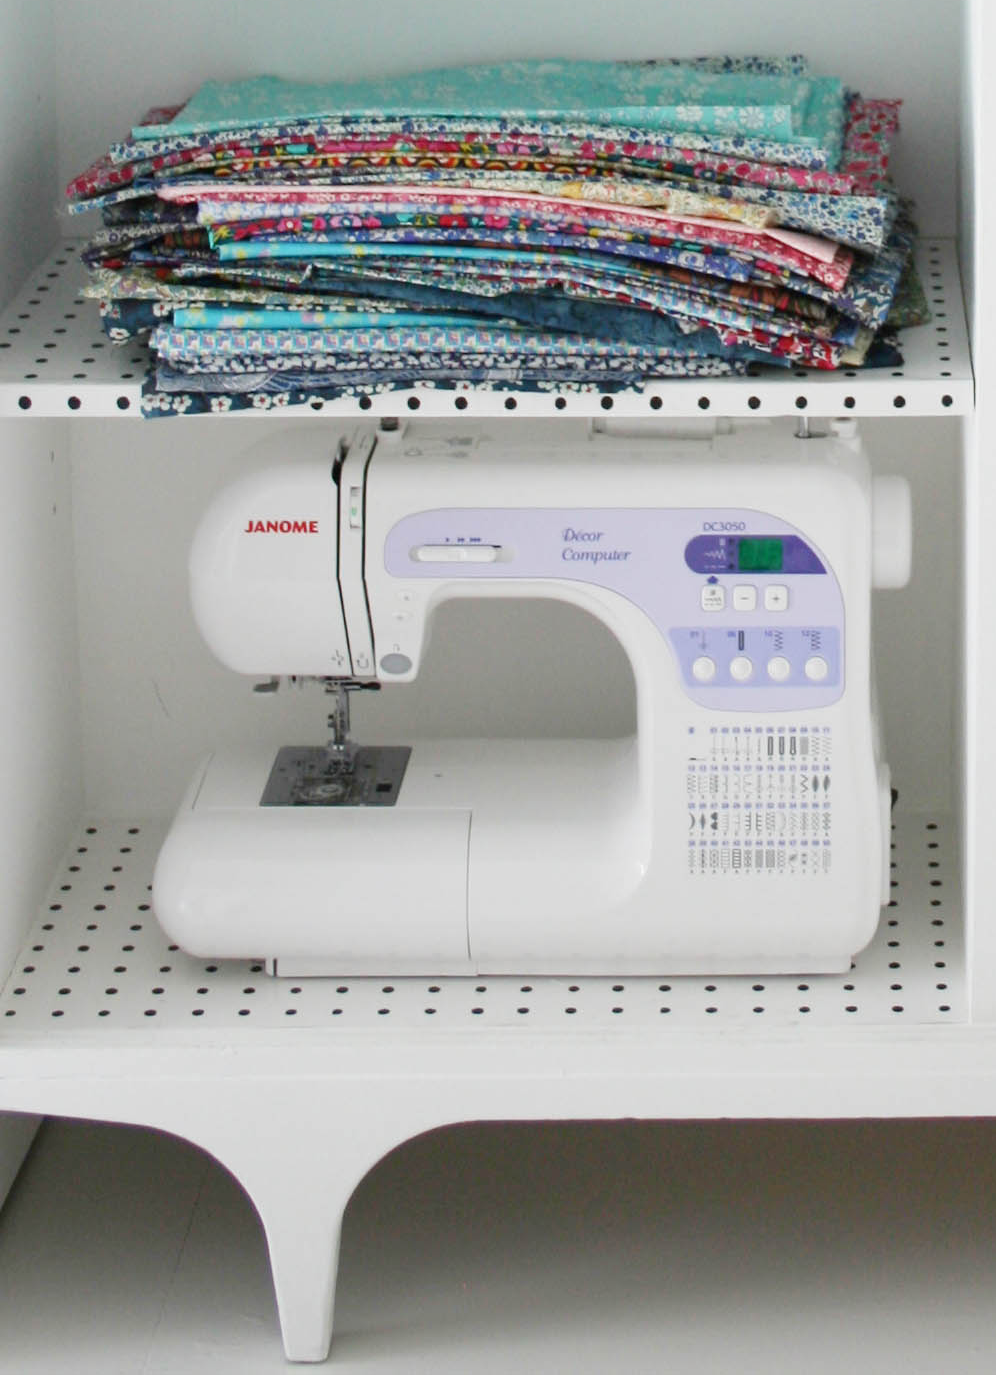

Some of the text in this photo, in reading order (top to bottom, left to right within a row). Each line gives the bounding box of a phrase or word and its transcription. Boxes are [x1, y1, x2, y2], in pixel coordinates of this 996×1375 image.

[245, 520, 319, 534] JANOME
[703, 521, 746, 532] DC3050
[562, 528, 605, 542] Décor
[562, 548, 632, 566] Computer
